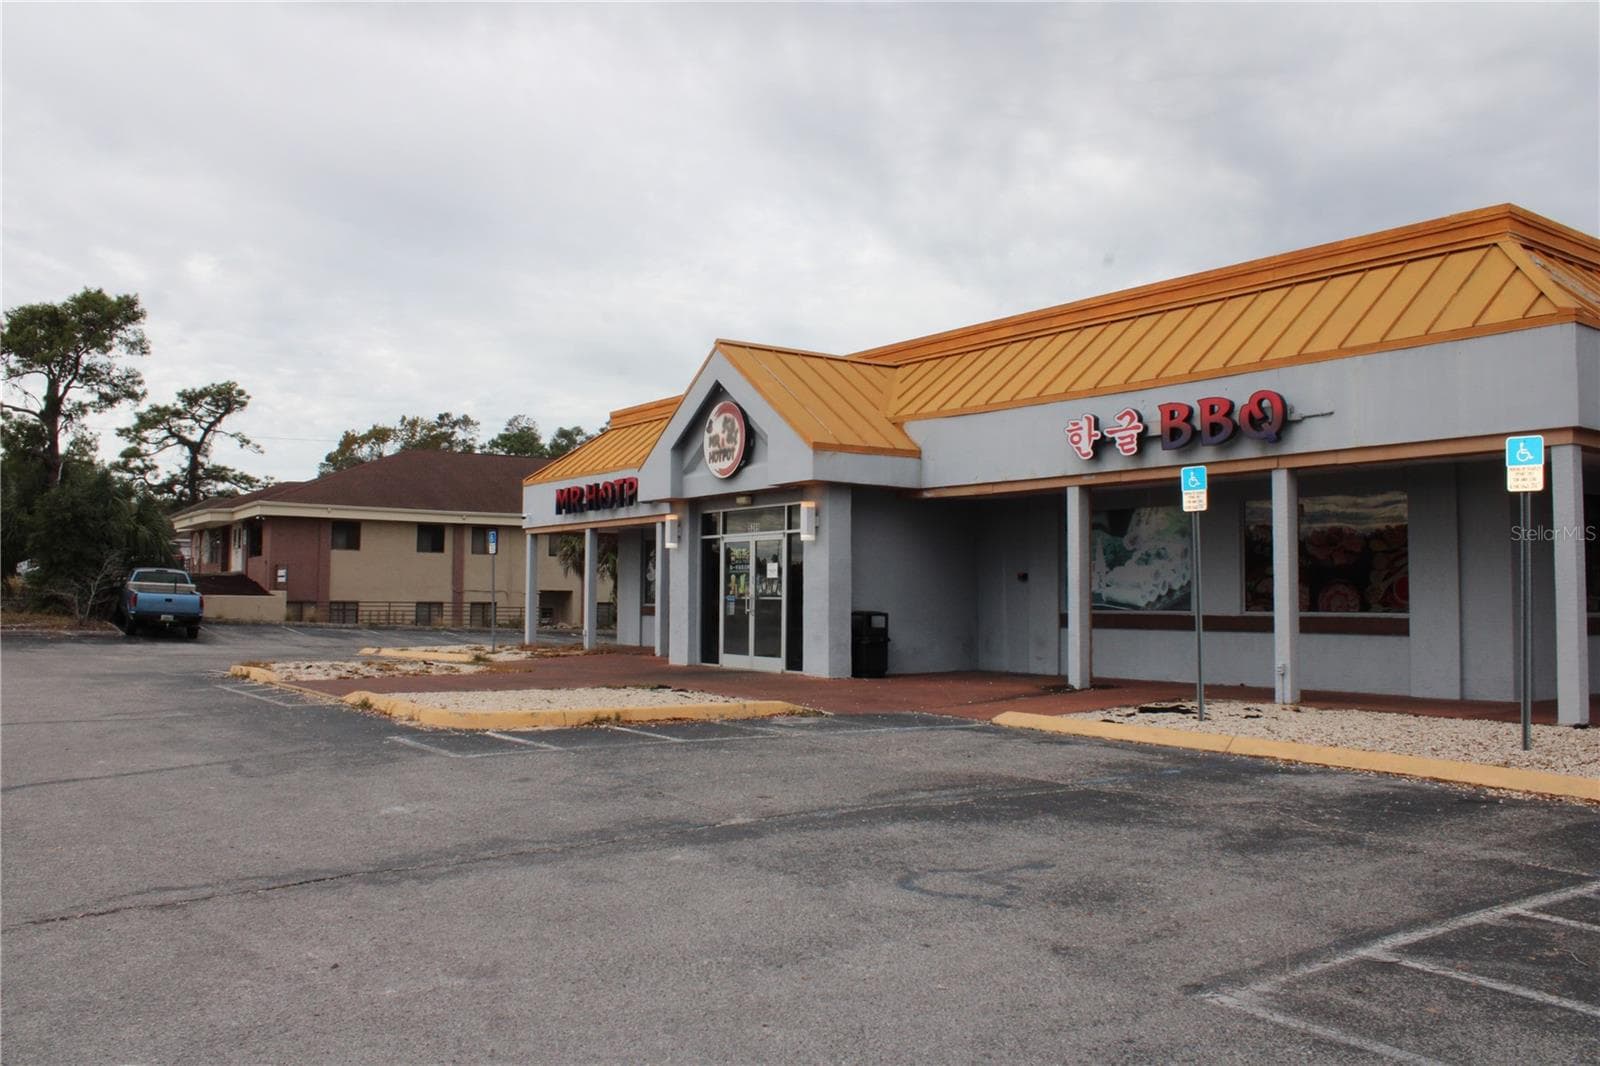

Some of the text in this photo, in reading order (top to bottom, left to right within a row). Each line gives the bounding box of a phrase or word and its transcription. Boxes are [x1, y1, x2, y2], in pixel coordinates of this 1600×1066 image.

[1065, 389, 1286, 460] 한글 BBQ
[708, 446, 737, 464] HOTPOT
